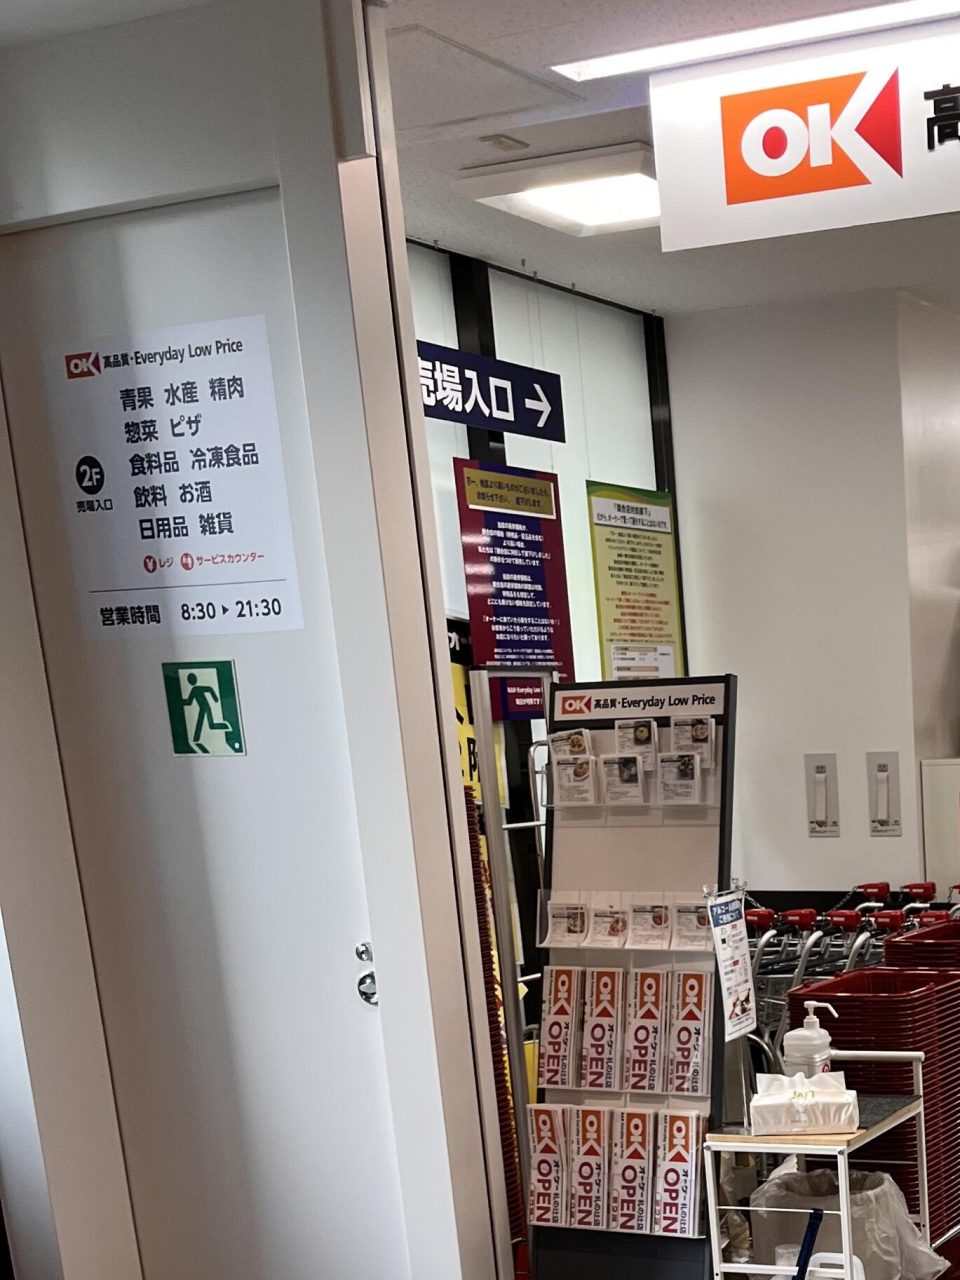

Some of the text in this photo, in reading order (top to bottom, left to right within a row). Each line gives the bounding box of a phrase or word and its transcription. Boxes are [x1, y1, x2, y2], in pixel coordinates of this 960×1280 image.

[738, 66, 904, 182] OK
[67, 352, 101, 376] OK
[188, 344, 212, 358] Low
[215, 338, 243, 355] Price
[119, 375, 245, 412] 青果 水産 精肉
[124, 413, 202, 443] 惣菜 ピザ
[80, 464, 101, 487] 2F
[129, 442, 259, 477] 食料品 冷凍食品
[134, 480, 213, 508] 飲料 お酒
[139, 511, 234, 540] 日用品 雑貨
[100, 598, 282, 626] 営業時間 8:30 21:30
[563, 696, 592, 713] OK
[668, 695, 689, 707] Low
[691, 693, 716, 706] Price
[546, 1021, 562, 1085] OPEN
[588, 1023, 606, 1088] OPEN
[631, 1025, 650, 1090] OPEN
[675, 1026, 692, 1092] OPEN
[536, 1159, 552, 1223] OPEN
[577, 1161, 594, 1226] OPEN
[620, 1165, 637, 1230] OPEN
[662, 1168, 680, 1234] OPEN
